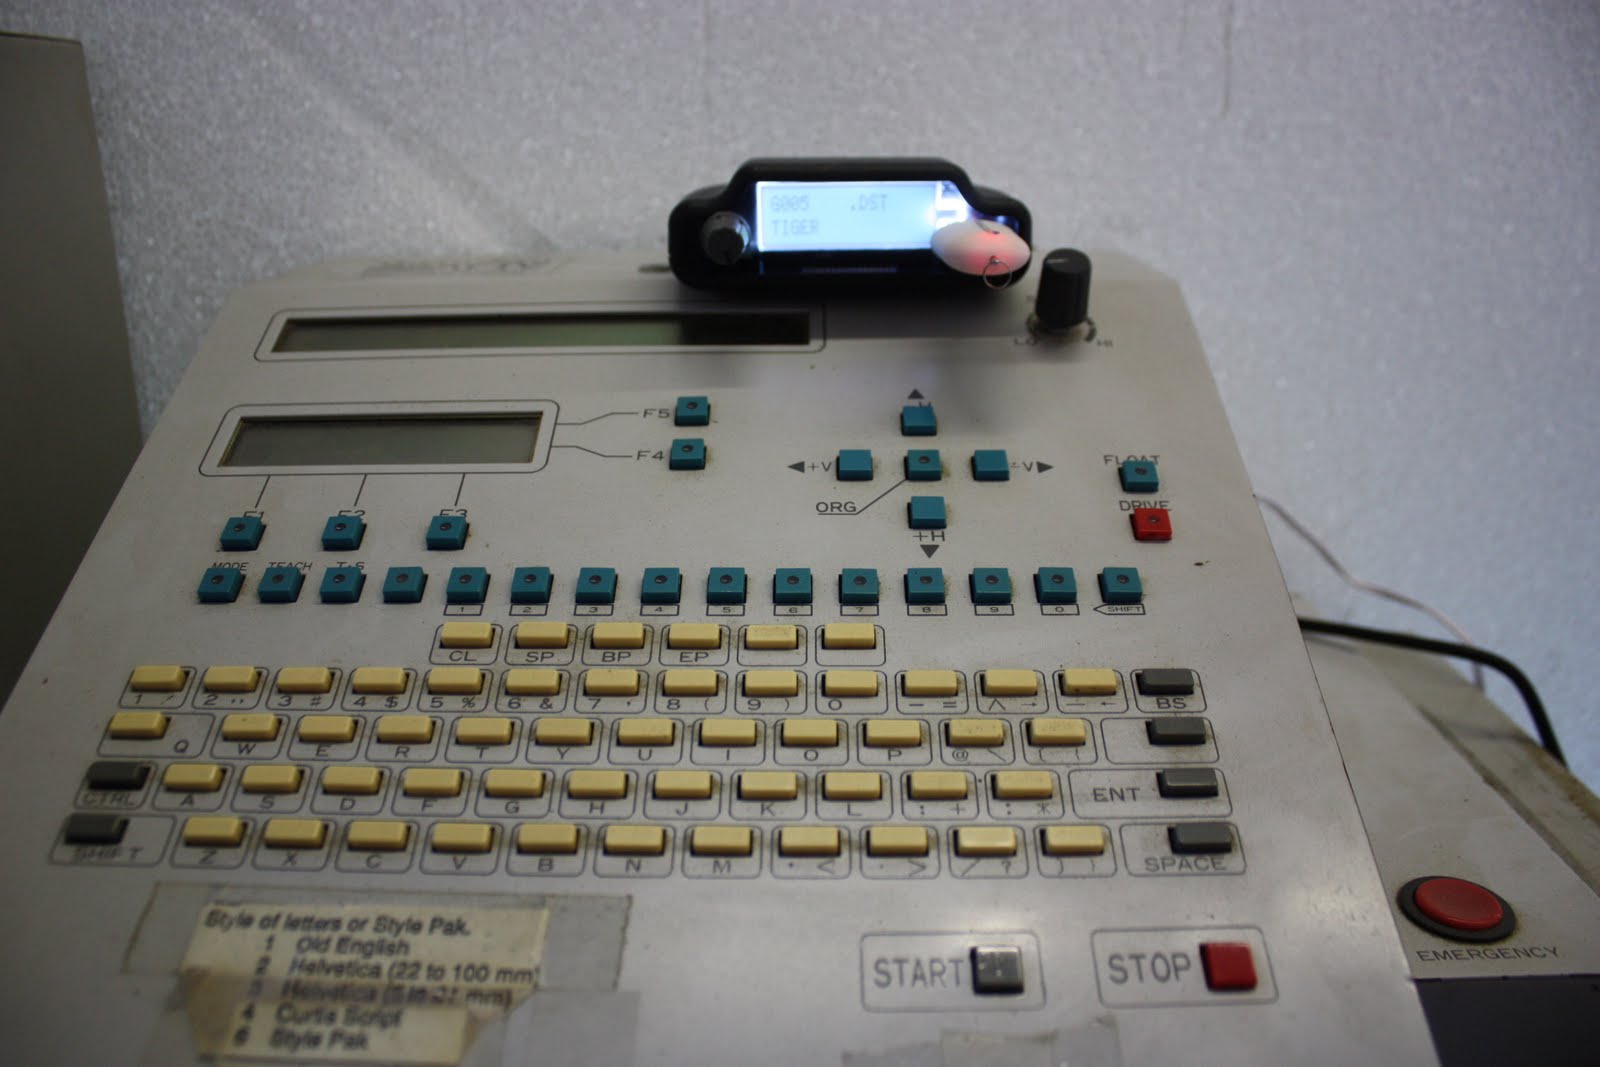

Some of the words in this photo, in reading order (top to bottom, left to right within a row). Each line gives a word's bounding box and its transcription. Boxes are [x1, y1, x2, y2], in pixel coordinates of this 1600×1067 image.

[772, 220, 819, 235] TIGER
[643, 409, 670, 418] F5
[637, 451, 664, 460] F4
[1104, 455, 1160, 465] FLOAT
[816, 502, 856, 513] ORG
[1119, 500, 1171, 511] DRIVE
[913, 531, 945, 542] +H
[449, 651, 477, 662] CL
[525, 652, 554, 662] SP
[602, 652, 632, 662] BP
[680, 652, 709, 662] EP
[135, 695, 143, 704] 1
[204, 695, 218, 705] 2
[278, 696, 292, 706] 3
[310, 697, 322, 706] #
[353, 697, 367, 706] 4
[385, 696, 399, 708] $
[430, 698, 444, 708] 5
[462, 697, 476, 708] %
[508, 699, 518, 709] 6
[539, 698, 554, 709] &
[588, 699, 601, 710] 7
[667, 699, 680, 710] 8
[747, 700, 761, 710] 9
[1156, 698, 1186, 709] BS
[173, 740, 189, 752] Q
[238, 744, 255, 755] W
[315, 746, 331, 757] E
[394, 746, 411, 758] R
[476, 748, 489, 759] T
[557, 748, 571, 759] Y
[638, 749, 652, 760] U
[888, 750, 902, 761] P
[951, 749, 969, 761] @
[180, 794, 194, 806] A
[1093, 787, 1141, 802] ENT
[259, 798, 275, 809] S
[339, 799, 356, 810] D
[421, 799, 438, 811] F
[504, 802, 520, 813] G
[589, 802, 606, 814] H
[676, 803, 689, 815] J
[760, 803, 777, 815] K
[847, 803, 862, 816] L
[199, 851, 217, 864] Z
[283, 854, 299, 866] X
[366, 855, 382, 869] C
[452, 858, 468, 870] V
[538, 859, 554, 871] B
[625, 860, 642, 872] N
[712, 861, 732, 873] M
[1001, 861, 1012, 874] ?
[1144, 857, 1227, 872] SPACE
[205, 909, 254, 931] Style
[259, 913, 280, 930] of
[283, 914, 345, 932] letters
[348, 918, 370, 934] or
[374, 916, 423, 936] Style
[428, 917, 471, 936] Pak.
[264, 935, 274, 950] 1
[296, 937, 332, 954] Old
[337, 939, 410, 957] English
[1416, 947, 1559, 962] EMERGENCY
[288, 960, 381, 980] Helvetica
[387, 961, 422, 983] (22
[427, 963, 449, 980] to
[453, 965, 491, 982] 100
[873, 957, 965, 988] START
[1108, 953, 1191, 984] STOP
[282, 982, 379, 1004] Helvetica
[344, 1008, 403, 1027] Script
[270, 1029, 322, 1051] Style
[327, 1030, 369, 1051] Pak
